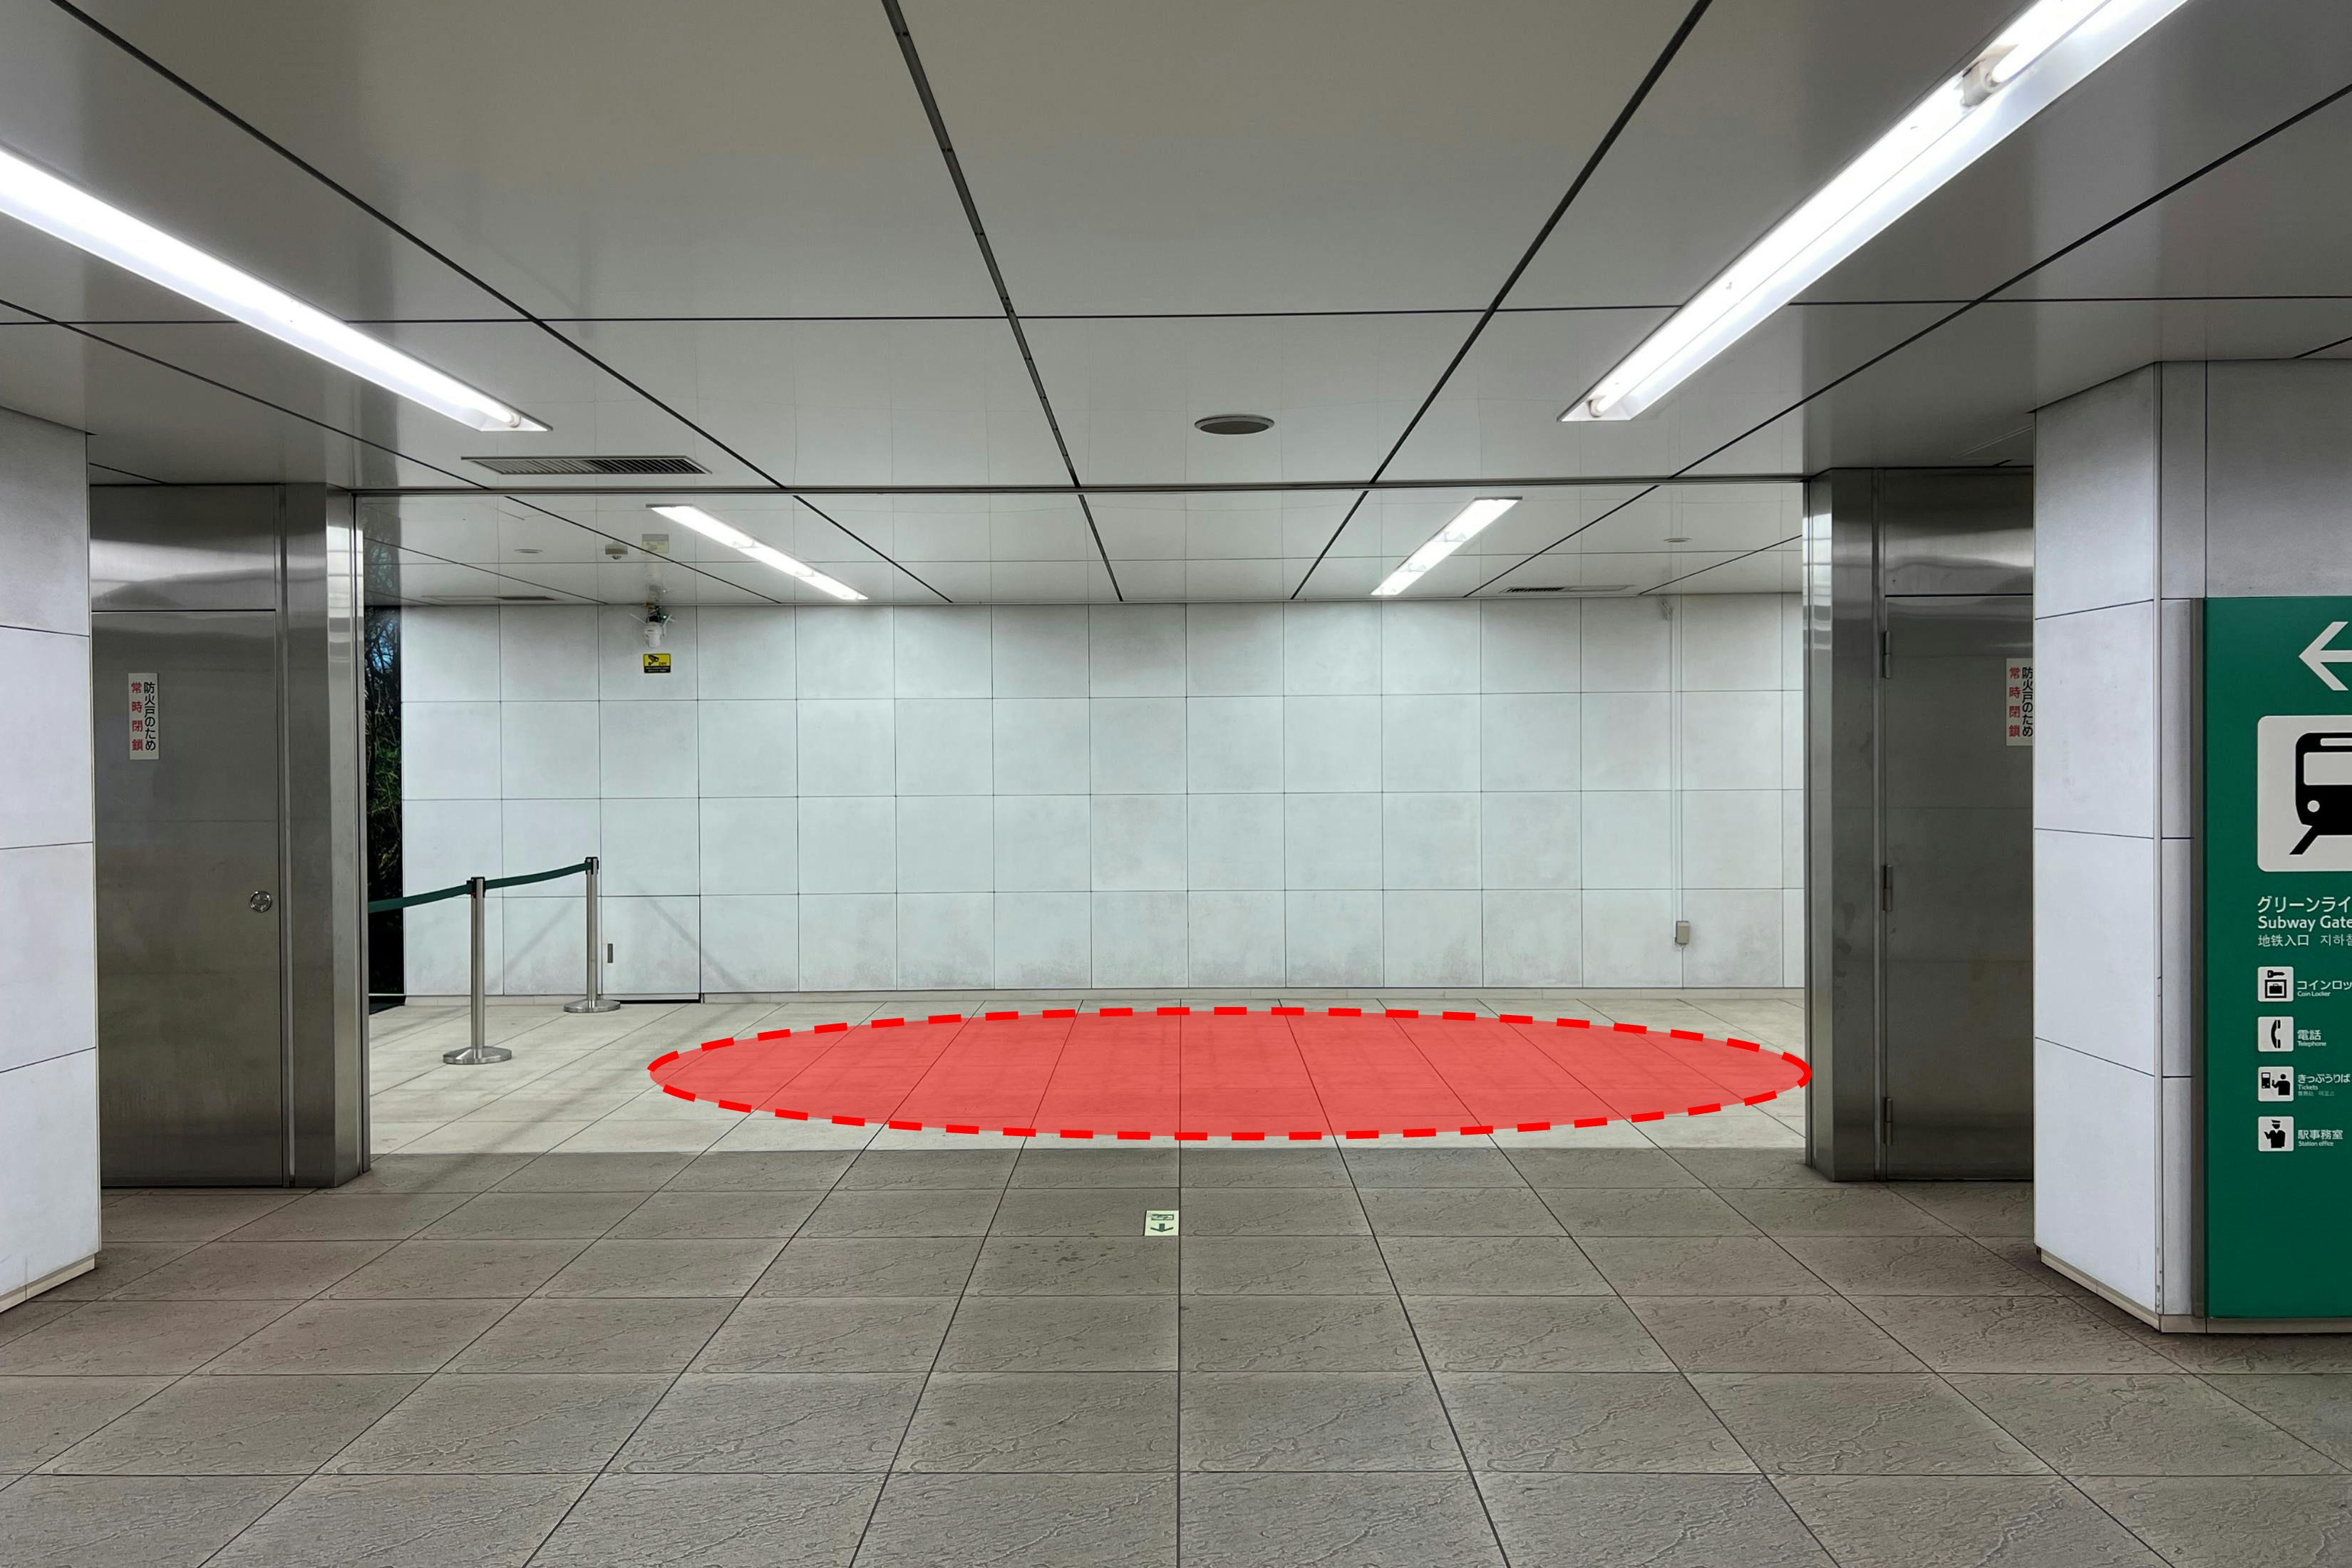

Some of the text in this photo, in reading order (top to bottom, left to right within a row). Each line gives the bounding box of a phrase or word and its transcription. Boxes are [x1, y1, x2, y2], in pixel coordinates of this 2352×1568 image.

[2009, 667, 2021, 738] 常時閉鎖
[2022, 667, 2033, 738] 防火戸のため
[131, 681, 144, 751] 常時閉鎖
[144, 682, 156, 751] 防火戸のため
[2257, 895, 2351, 913] グリーンライ
[2257, 914, 2352, 932] Subway Gate
[2257, 934, 2309, 947] 地铁入口
[2297, 979, 2352, 991] コインロッ
[2297, 1029, 2321, 1041] 電話
[2297, 1129, 2343, 1140] 駅事務室
